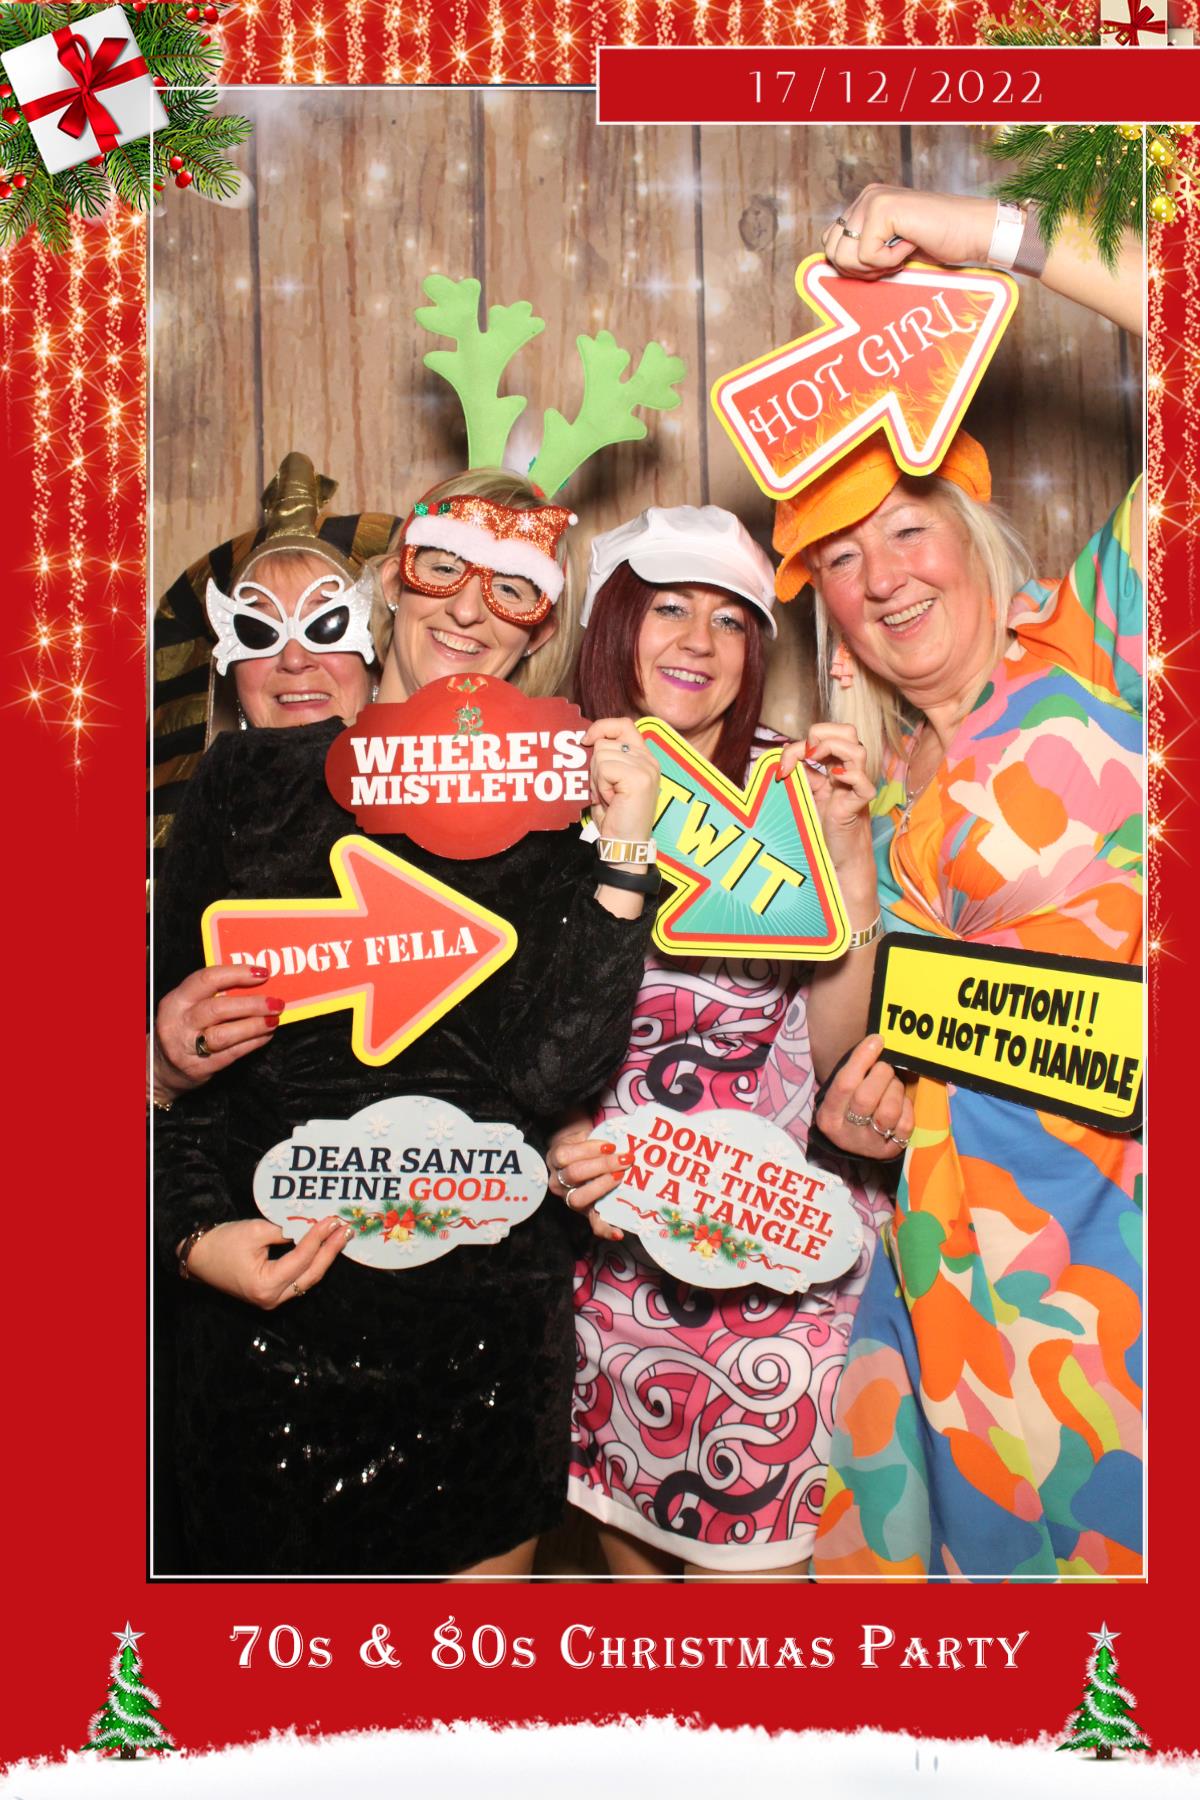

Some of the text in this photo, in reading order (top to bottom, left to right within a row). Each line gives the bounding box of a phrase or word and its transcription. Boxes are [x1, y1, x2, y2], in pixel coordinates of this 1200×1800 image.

[748, 290, 978, 446] HOT GIRL
[350, 730, 588, 774] WHERE'S
[350, 770, 590, 806] MISTLETOE
[651, 772, 808, 917] TWIT
[364, 926, 479, 966] FELLA
[957, 976, 1100, 1037] CAUTION!!
[887, 1003, 1140, 1102] TOO HOT TO HANDLE
[269, 1175, 528, 1202] DEFINE GOOD...
[288, 1145, 522, 1175] DEAR SANTA
[625, 1133, 834, 1238] YOUR TINSEL
[647, 1116, 826, 1202] DON'T GET
[623, 1164, 829, 1261] N A TANGLE
